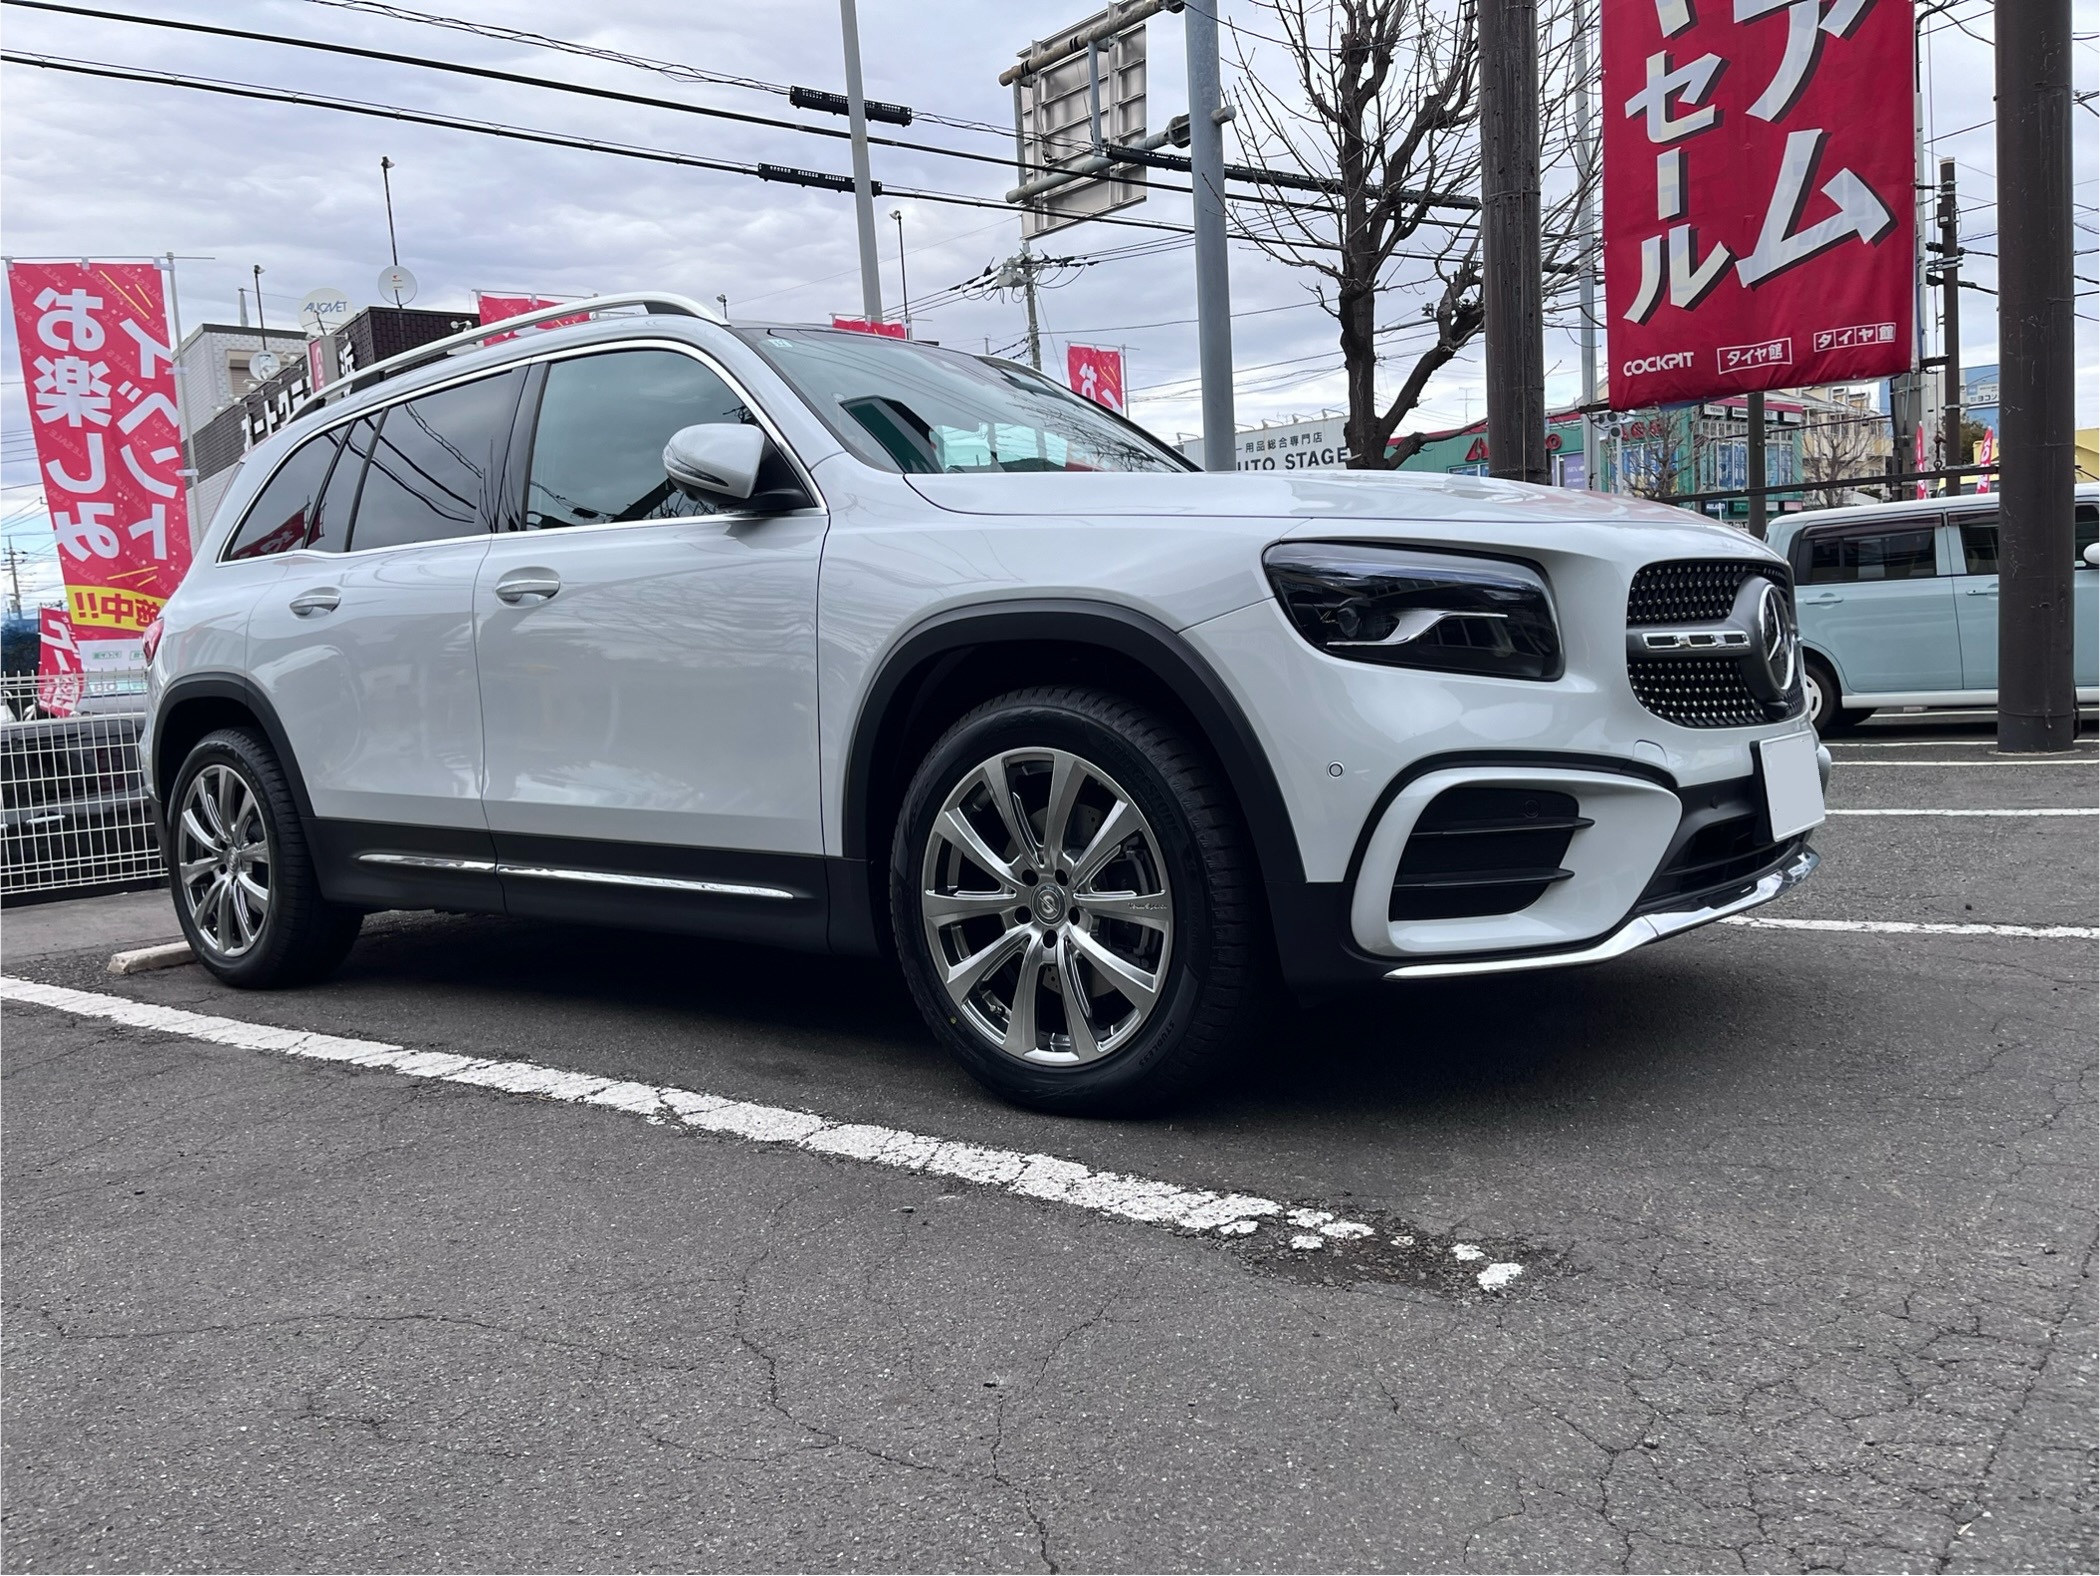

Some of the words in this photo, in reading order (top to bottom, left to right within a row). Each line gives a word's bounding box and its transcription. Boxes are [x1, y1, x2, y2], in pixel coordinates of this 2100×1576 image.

[1818, 324, 1896, 350] タイヤ館
[1623, 351, 1694, 377] COCKPIT
[1727, 344, 1784, 366] タイヤ館
[1285, 446, 1348, 470] STAGE
